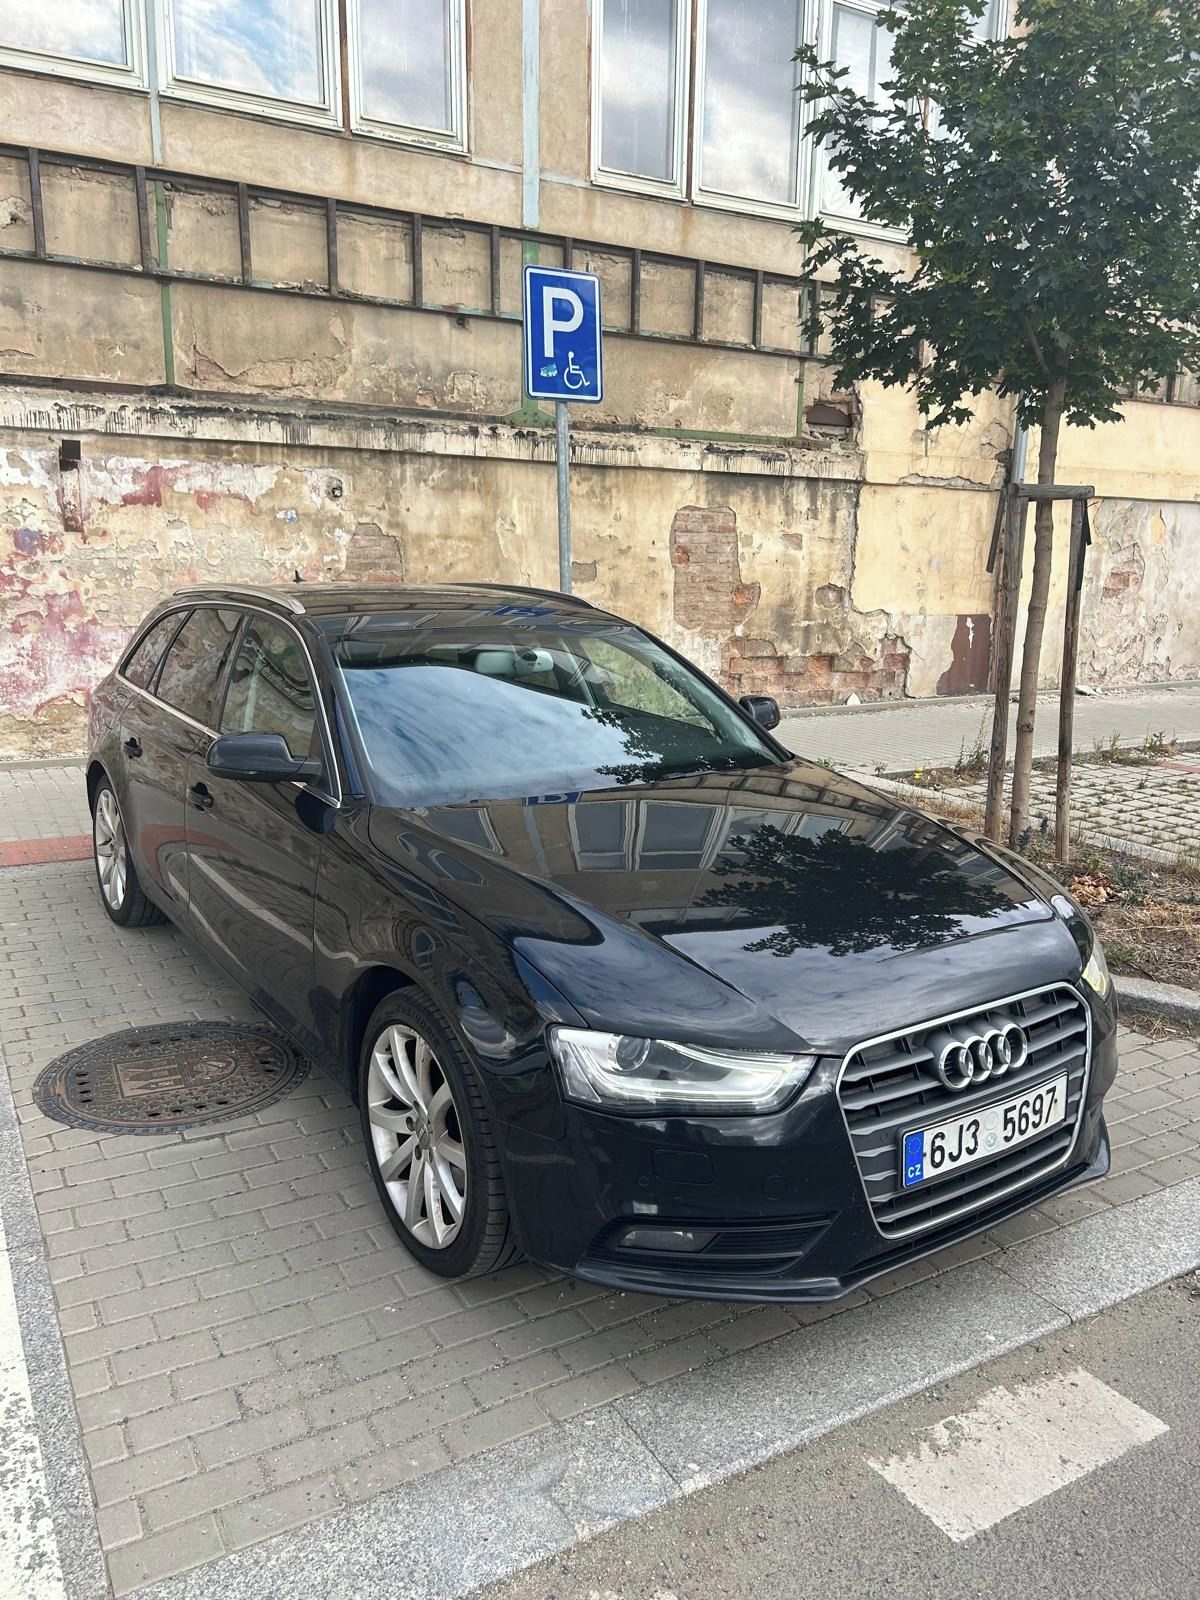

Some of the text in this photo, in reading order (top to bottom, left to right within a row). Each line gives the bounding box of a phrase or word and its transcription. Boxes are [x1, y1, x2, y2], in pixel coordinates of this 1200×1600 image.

[543, 286, 584, 358] P
[930, 1085, 1057, 1169] 6J3 5697
[908, 1164, 921, 1178] CZ
